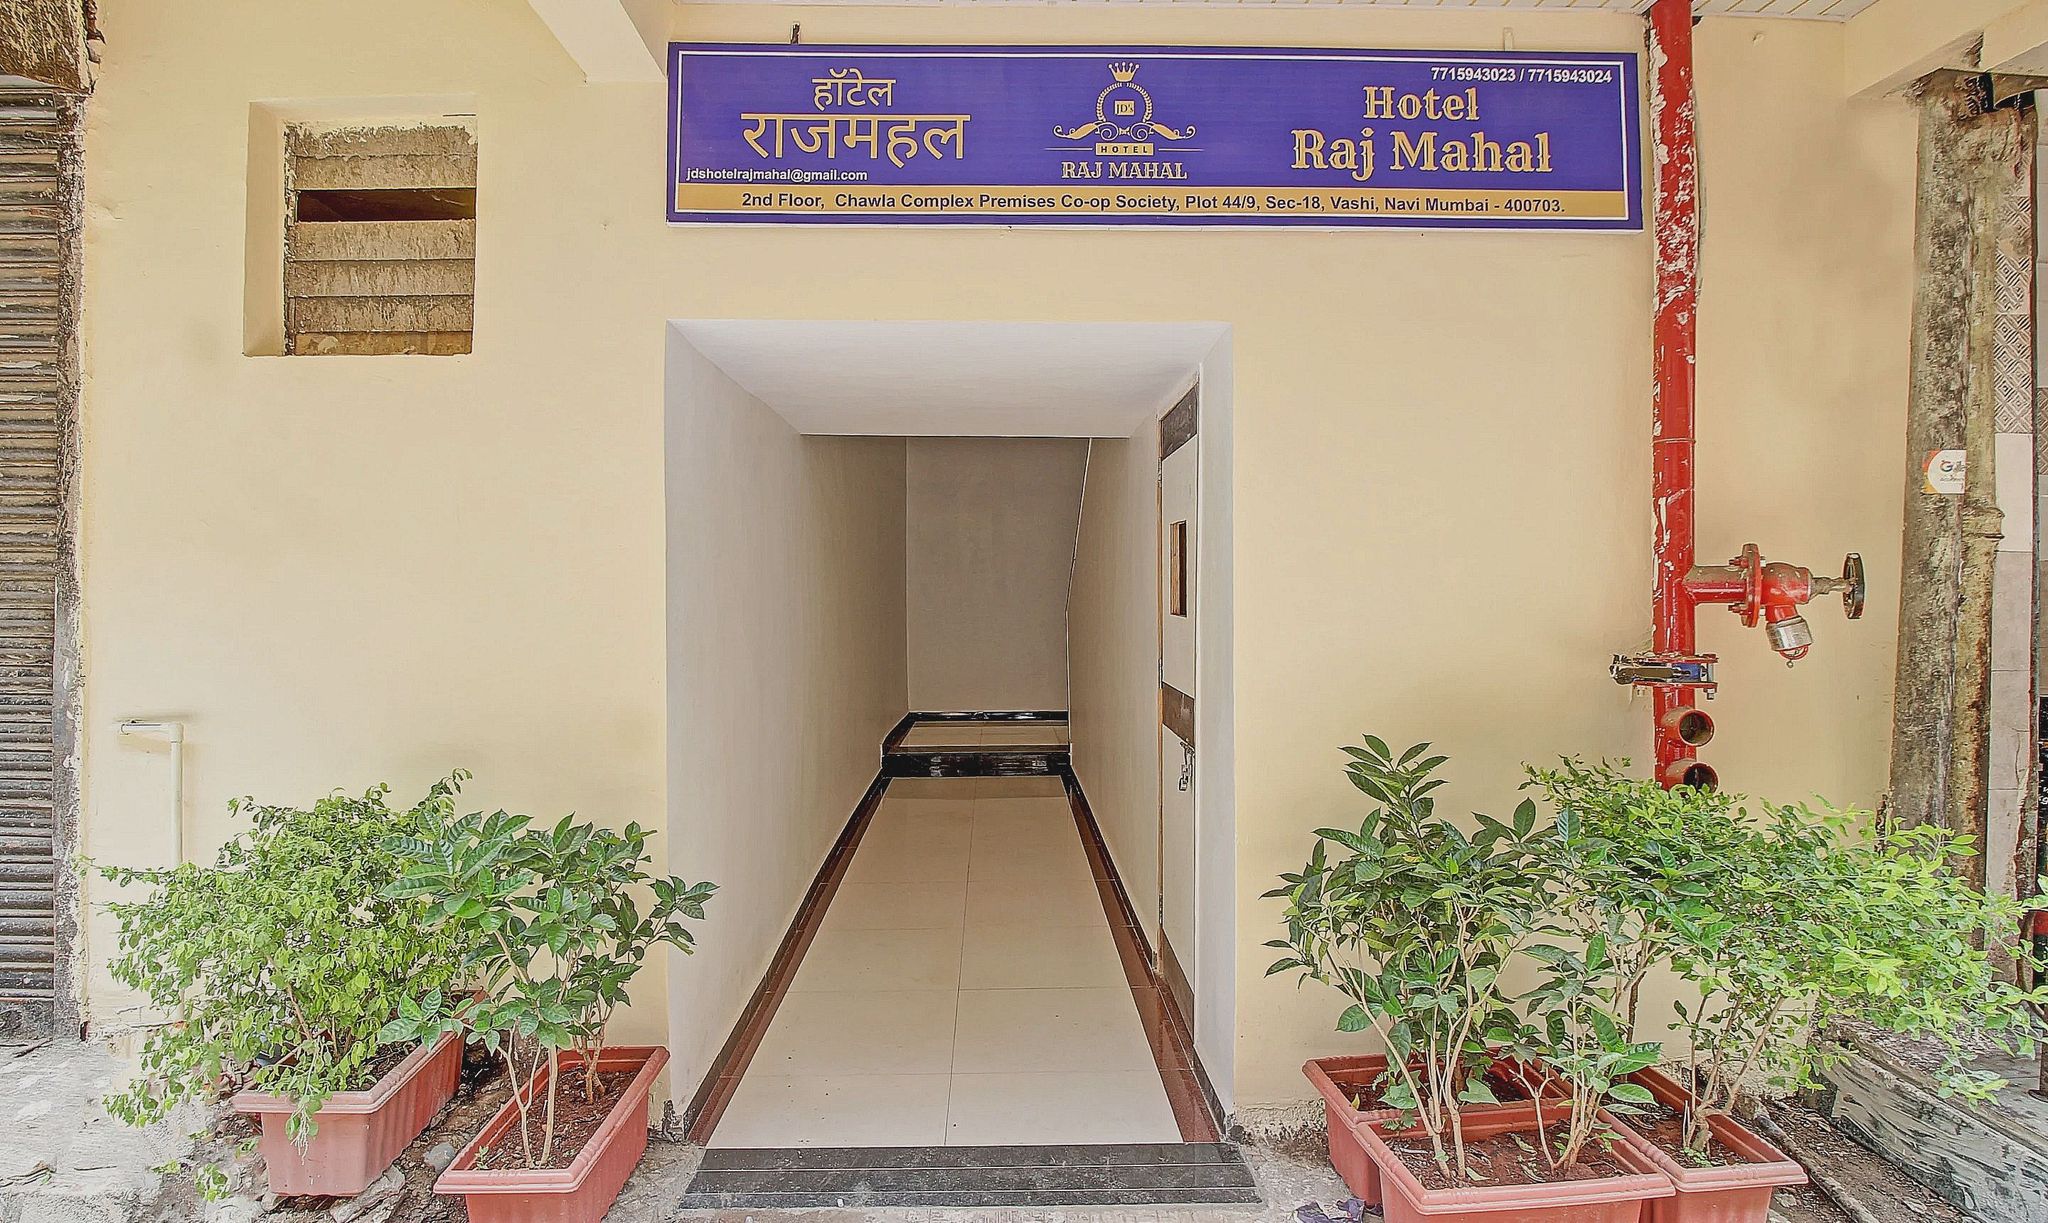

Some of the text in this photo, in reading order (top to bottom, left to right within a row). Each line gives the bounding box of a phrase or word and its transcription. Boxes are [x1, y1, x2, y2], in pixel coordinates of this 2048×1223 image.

[1431, 66, 1516, 82] 7715943023
[1527, 67, 1613, 83] 7715943024
[811, 68, 897, 111] हॉटेल
[1362, 85, 1480, 121] Hotel
[740, 113, 971, 169] राजमहल
[1100, 145, 1148, 153] HOTEL
[1290, 127, 1554, 181] Raj Mahal
[686, 167, 868, 183] jdshotelrajmahal@gmail.com
[1061, 161, 1188, 180] RAJ MAHAL
[741, 192, 773, 207] 2nd
[778, 193, 825, 210] Floor,
[835, 193, 896, 208] Chawla
[900, 193, 974, 211] Complex
[979, 194, 1056, 208] Premises
[1061, 194, 1111, 211] Co-op
[1115, 195, 1180, 211] Society,
[1185, 195, 1218, 209] Plot
[1222, 195, 1260, 211] 44/9,
[1265, 196, 1325, 211] Sec-18,
[1330, 196, 1379, 212] Vashi,
[1384, 197, 1420, 211] Navi
[1425, 198, 1489, 212] Mumbai
[1504, 198, 1565, 212] 400703.
